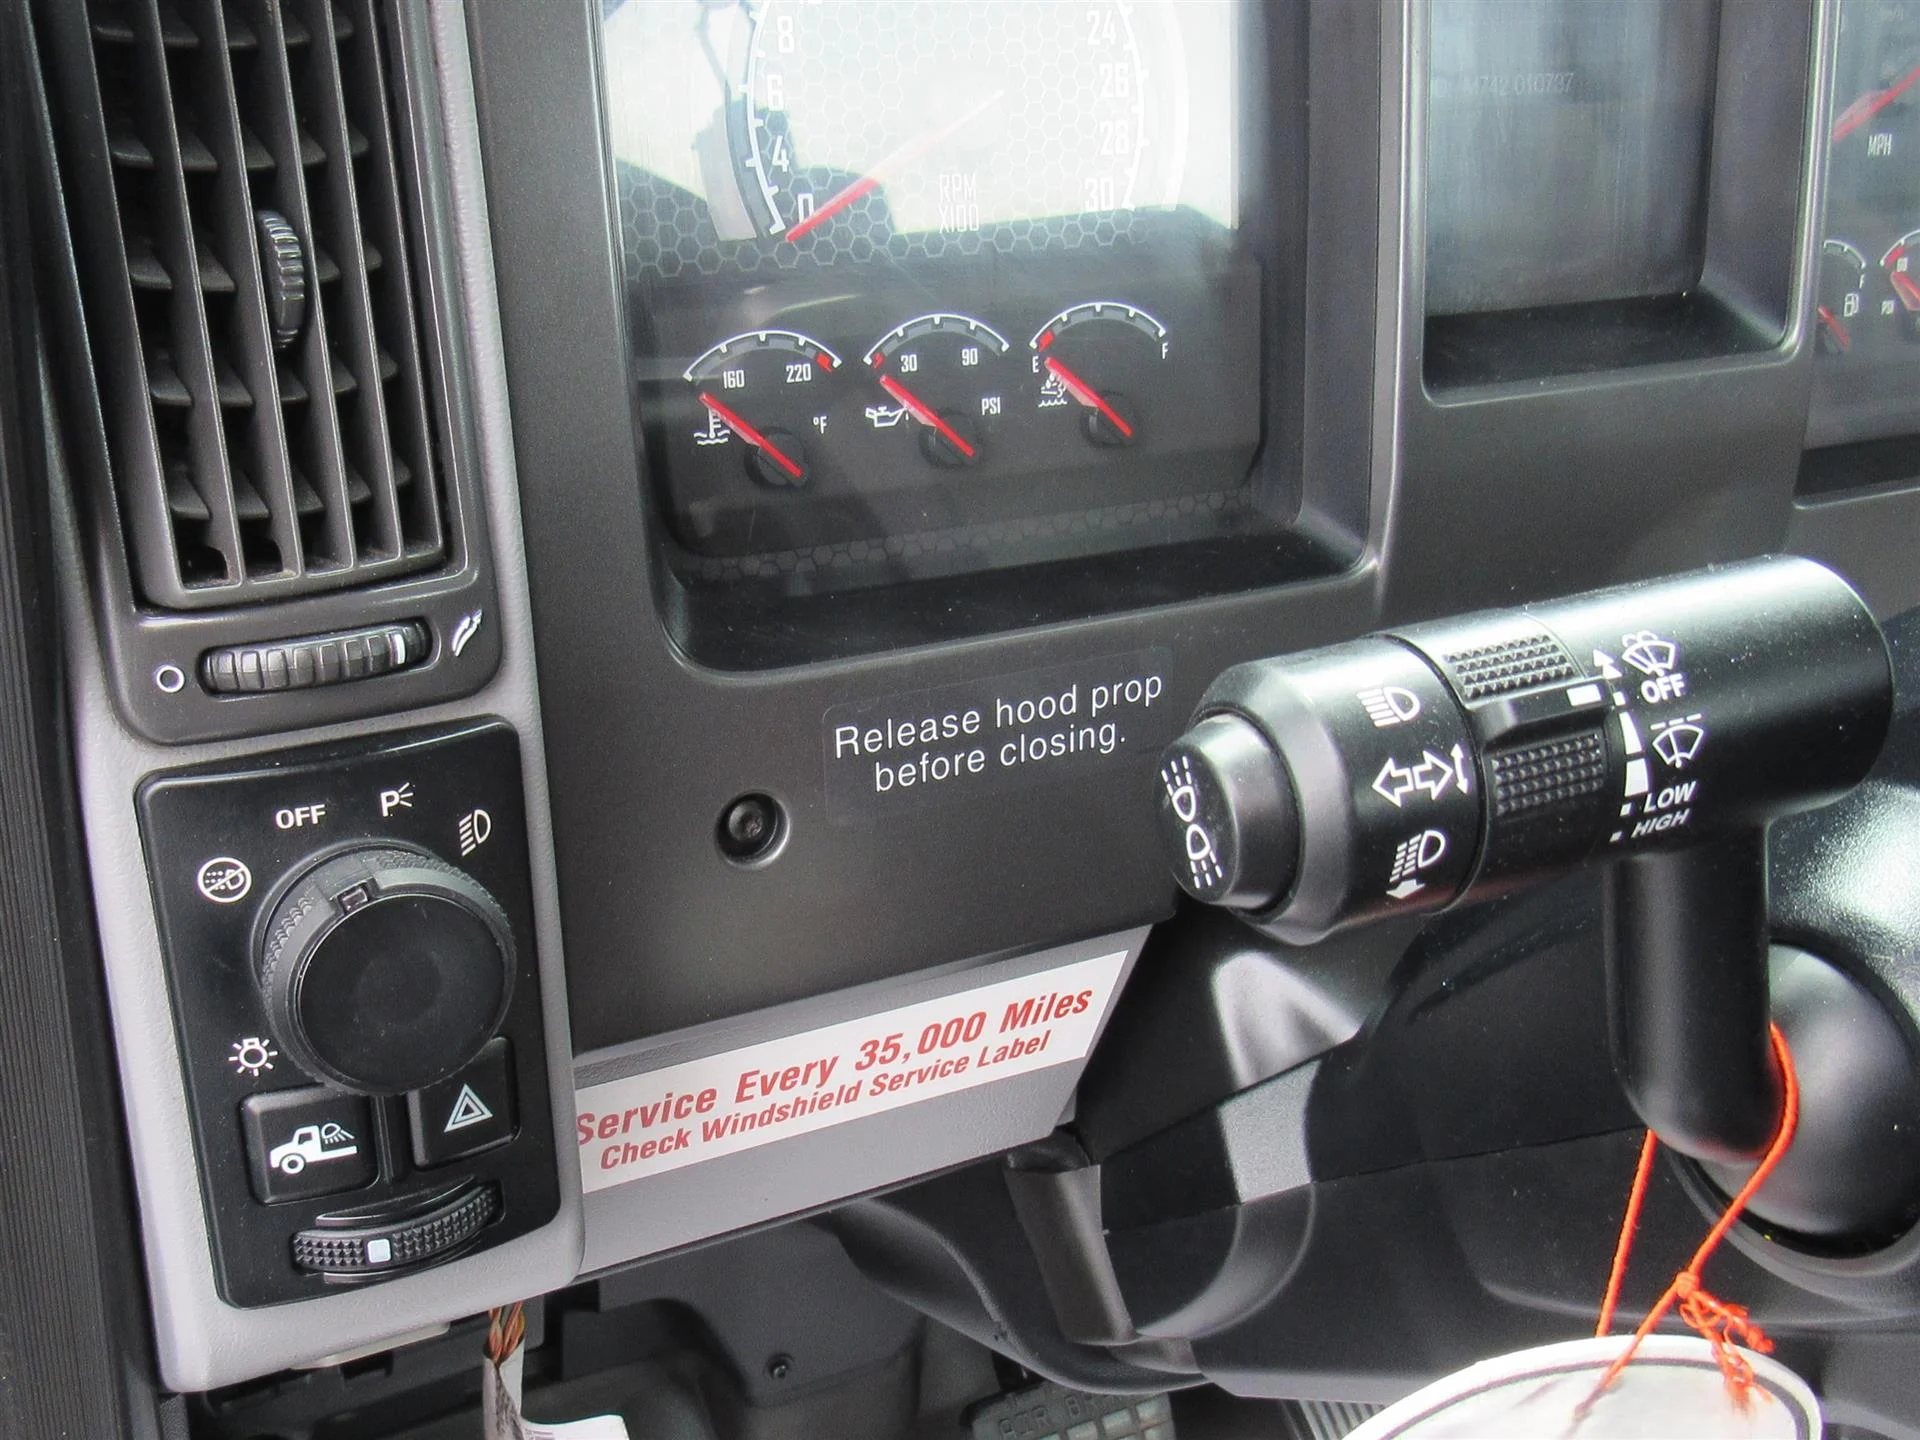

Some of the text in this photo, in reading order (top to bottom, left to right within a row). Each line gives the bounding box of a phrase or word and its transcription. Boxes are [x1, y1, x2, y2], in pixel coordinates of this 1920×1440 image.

[776, 15, 795, 54] 8
[1085, 9, 1117, 46] 24
[766, 73, 785, 111] 6
[1099, 62, 1130, 98] 26
[1099, 119, 1130, 155] 28
[1867, 132, 1893, 157] MPH
[772, 135, 790, 173] 4
[938, 172, 977, 202] RPM
[1083, 176, 1115, 212] 30
[937, 203, 980, 233] X100
[900, 348, 979, 373] 30 90
[1031, 356, 1040, 374] E
[1161, 341, 1169, 360] F
[722, 363, 812, 389] 160 220
[981, 395, 1003, 416] PSI
[1640, 673, 1685, 704] OFF
[834, 674, 1163, 759] Release hood prop
[875, 722, 1126, 792] before closing.
[1643, 780, 1697, 813] LOW
[275, 803, 327, 830] OFF
[1630, 808, 1691, 839] HIGH
[576, 987, 1094, 1146] Service Every 35,000 Miles
[600, 1029, 1052, 1169] Check Windshield Service Label
